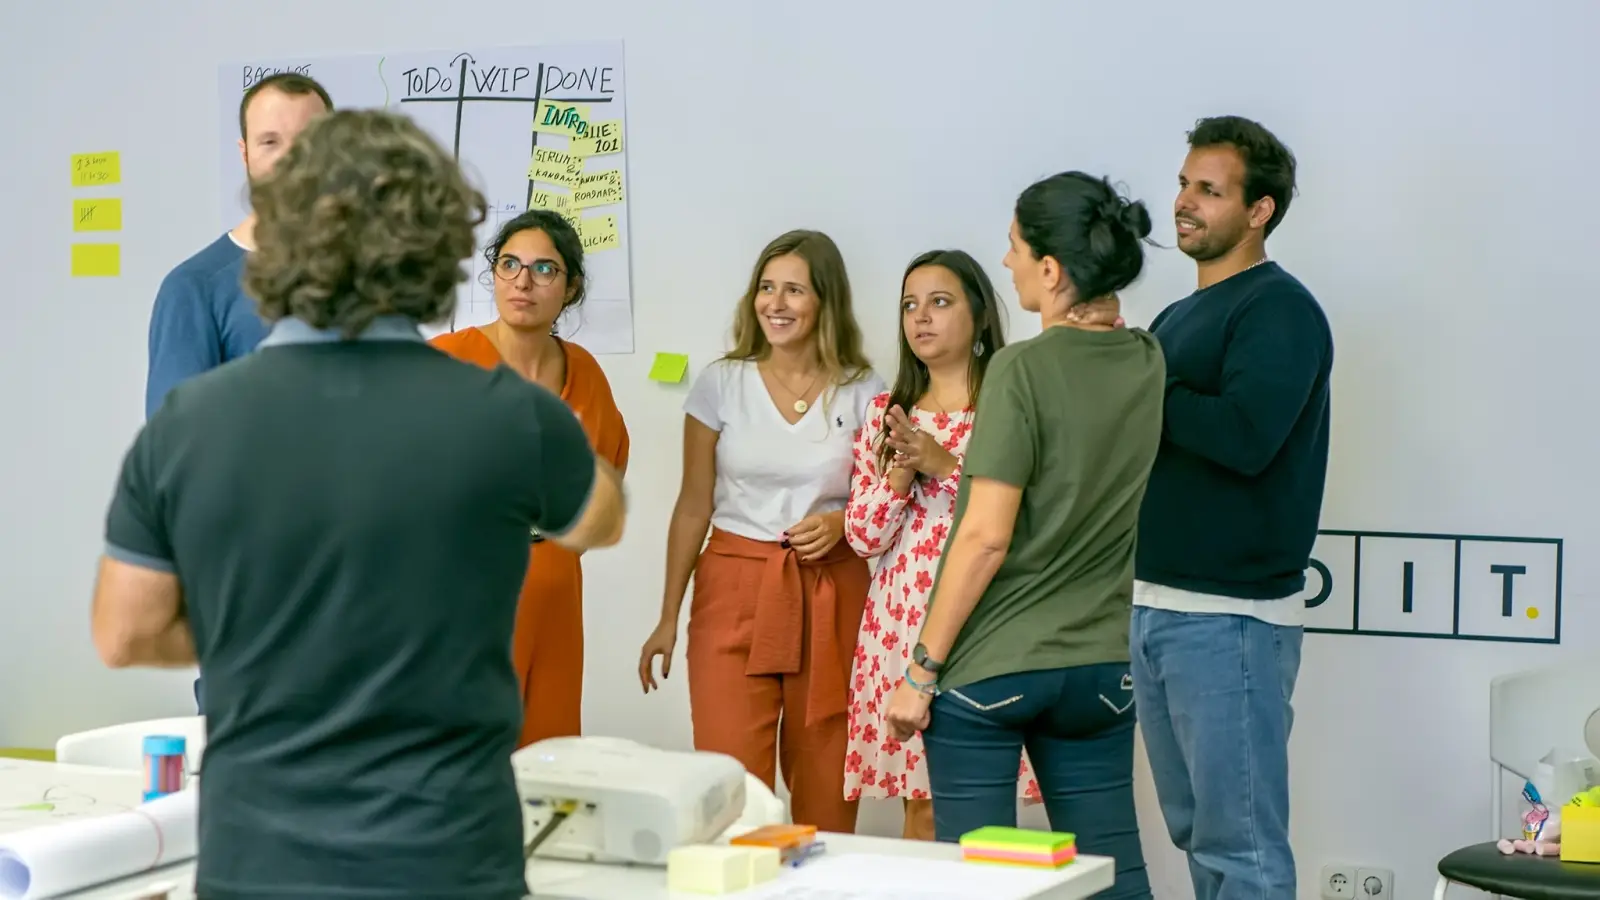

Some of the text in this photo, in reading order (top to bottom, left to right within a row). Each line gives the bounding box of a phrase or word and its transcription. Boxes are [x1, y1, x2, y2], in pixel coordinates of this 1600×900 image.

[470, 66, 530, 93] WIP
[541, 105, 588, 135] INTRO
[594, 138, 618, 153] 101
[535, 149, 571, 165] SCRUM
[583, 234, 615, 248] LICING
